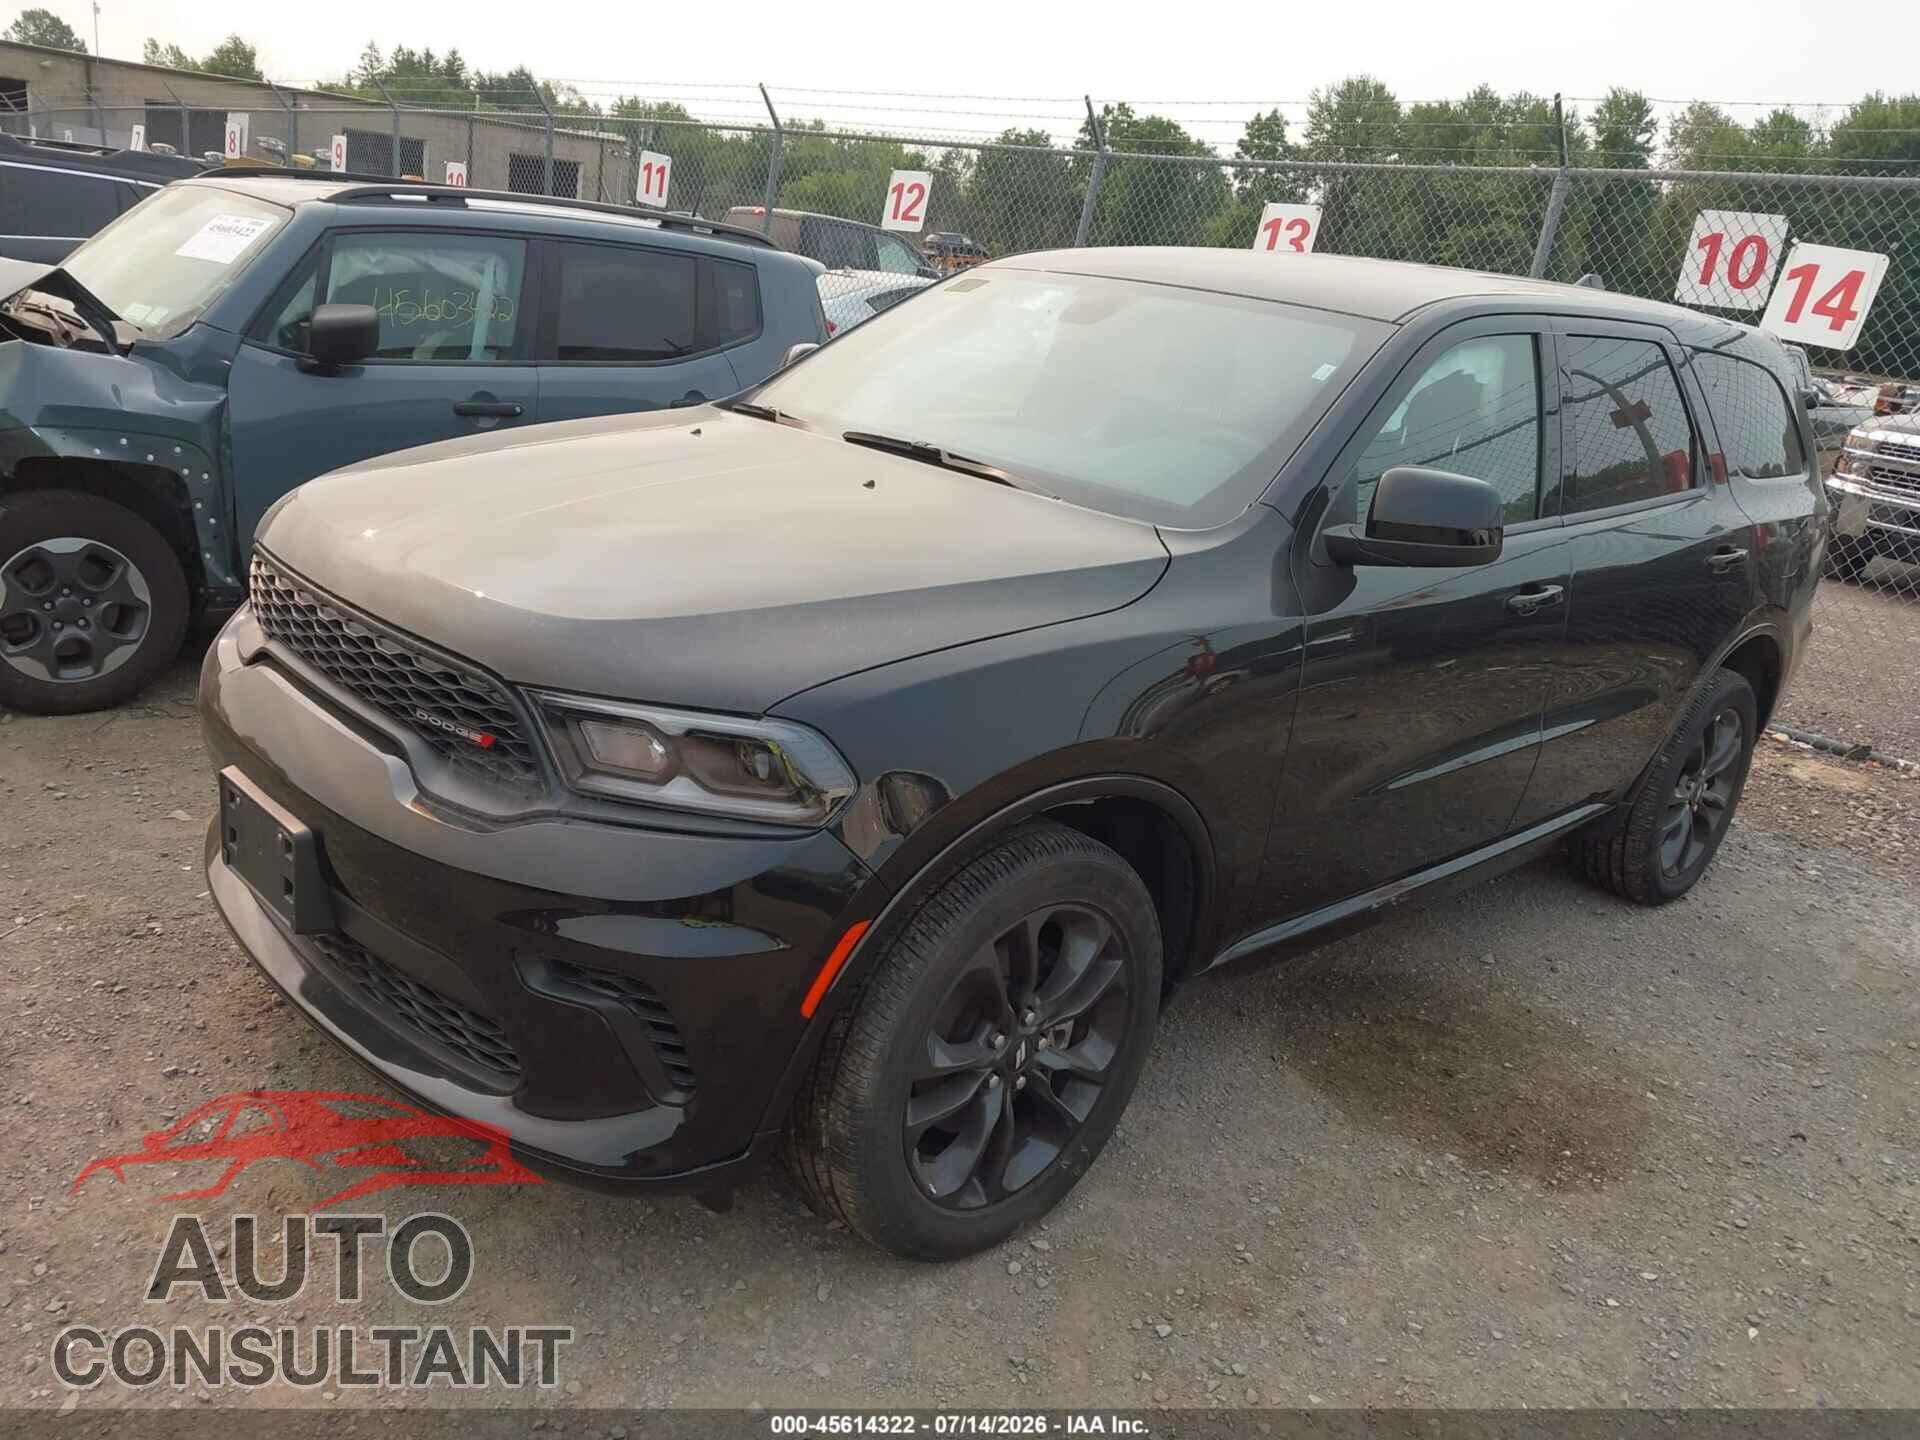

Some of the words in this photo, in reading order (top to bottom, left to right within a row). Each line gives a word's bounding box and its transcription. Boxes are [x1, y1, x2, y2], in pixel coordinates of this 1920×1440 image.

[228, 130, 236, 152] 8
[335, 143, 343, 168] 9
[643, 162, 666, 198] 11
[891, 182, 925, 222] 12
[1263, 217, 1311, 252] 13
[1697, 232, 1769, 290] 10
[1785, 263, 1866, 331] 14
[415, 709, 482, 743] DODGE
